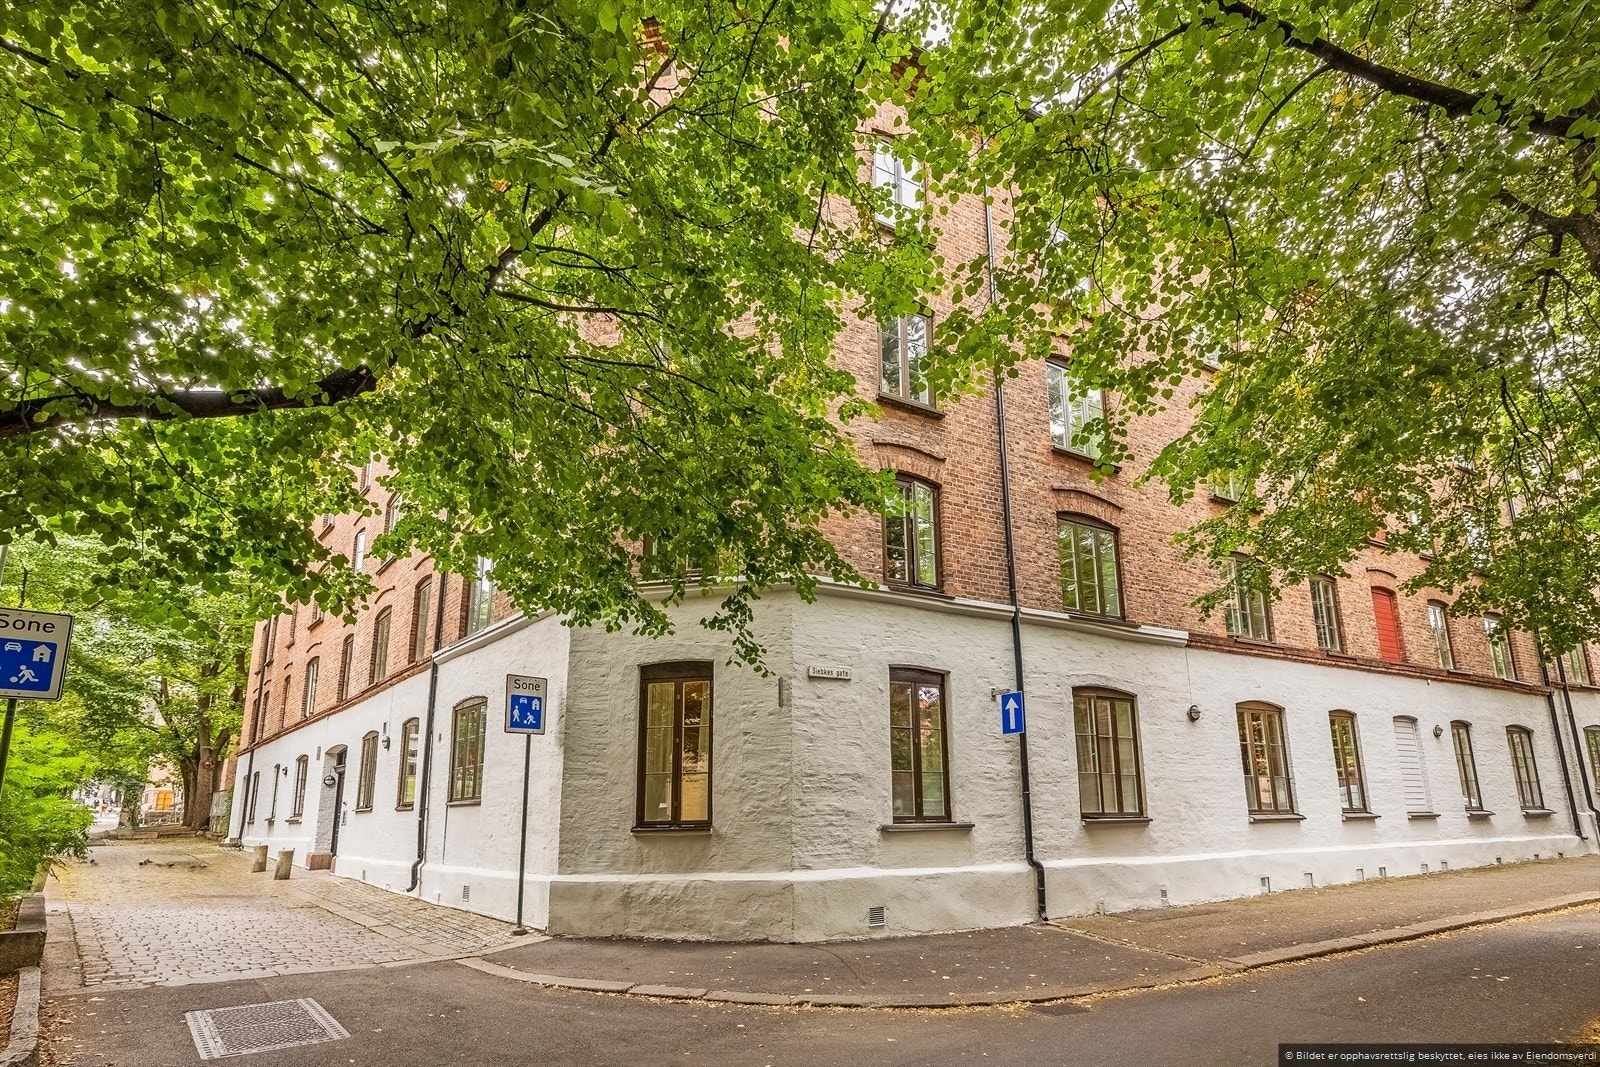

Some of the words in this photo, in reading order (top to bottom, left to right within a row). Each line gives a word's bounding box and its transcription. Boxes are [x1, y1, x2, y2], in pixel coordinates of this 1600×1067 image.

[0, 613, 56, 634] Sone
[836, 670, 849, 678] gate
[514, 678, 541, 691] Sone
